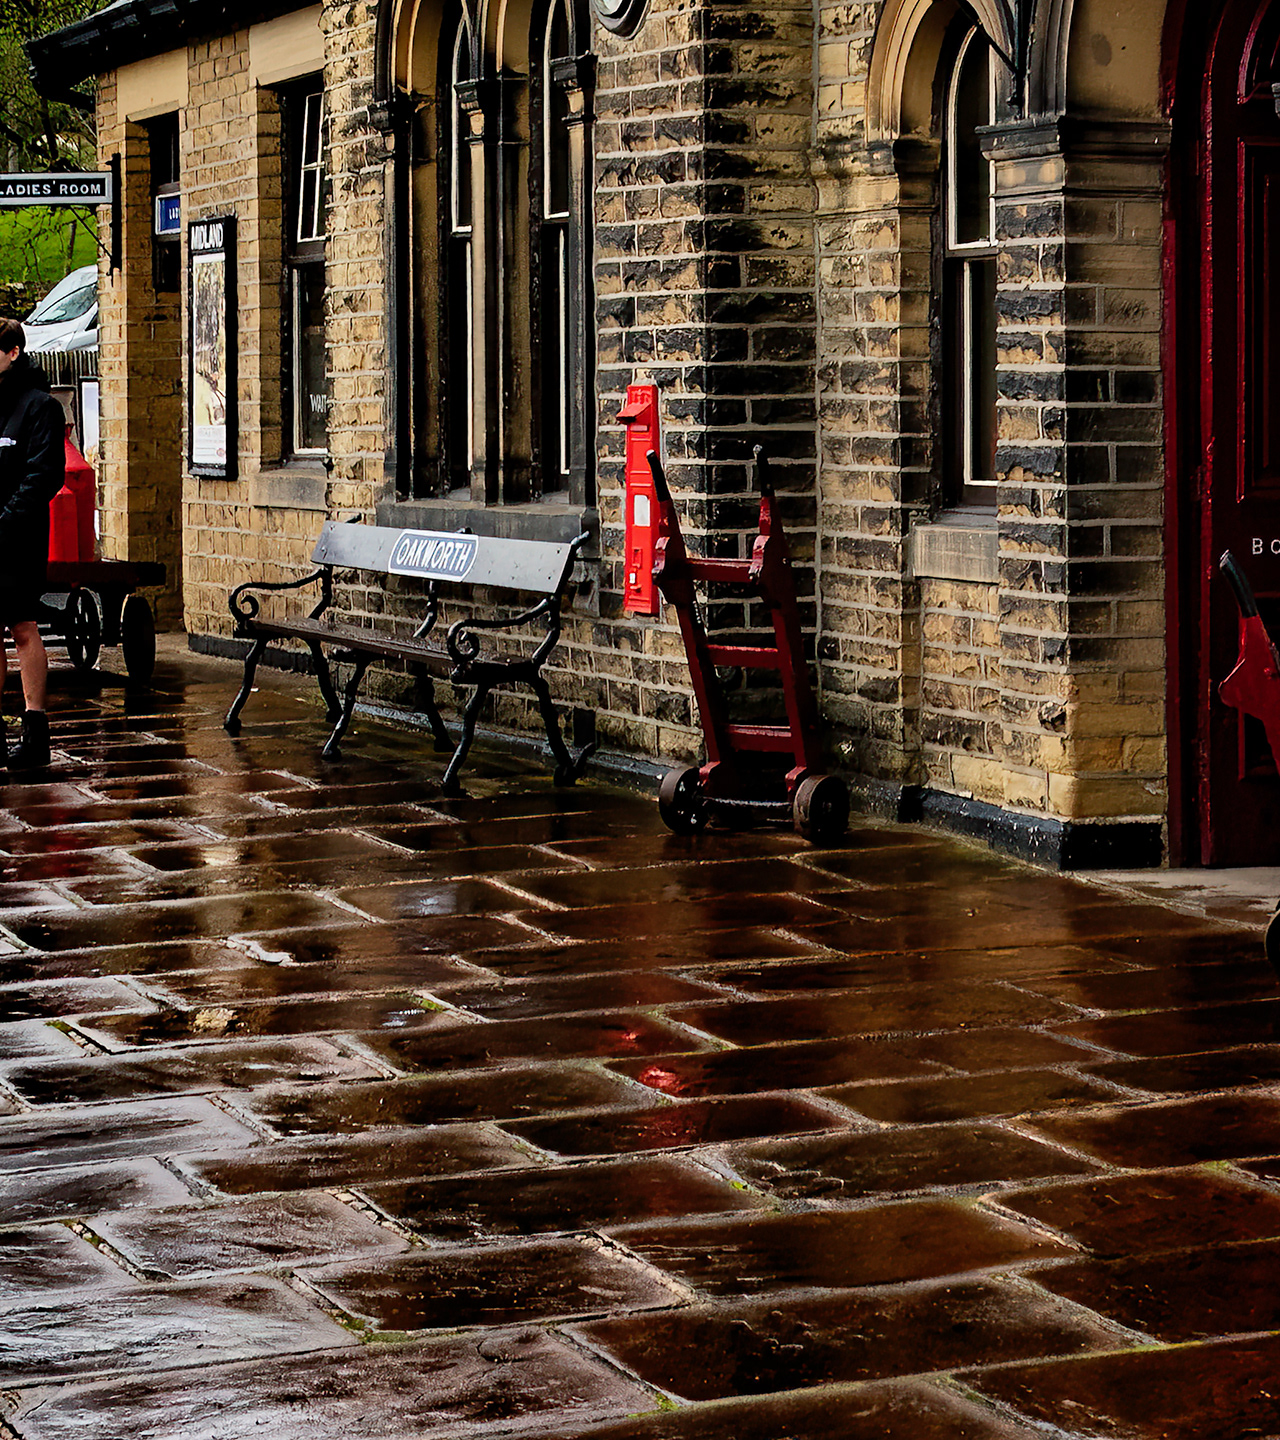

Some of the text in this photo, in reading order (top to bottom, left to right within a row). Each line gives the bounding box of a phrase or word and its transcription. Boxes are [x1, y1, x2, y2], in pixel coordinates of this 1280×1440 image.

[59, 184, 100, 195] ROOM
[191, 222, 224, 250] MIDLAND
[396, 538, 472, 572] OAKWORTH
